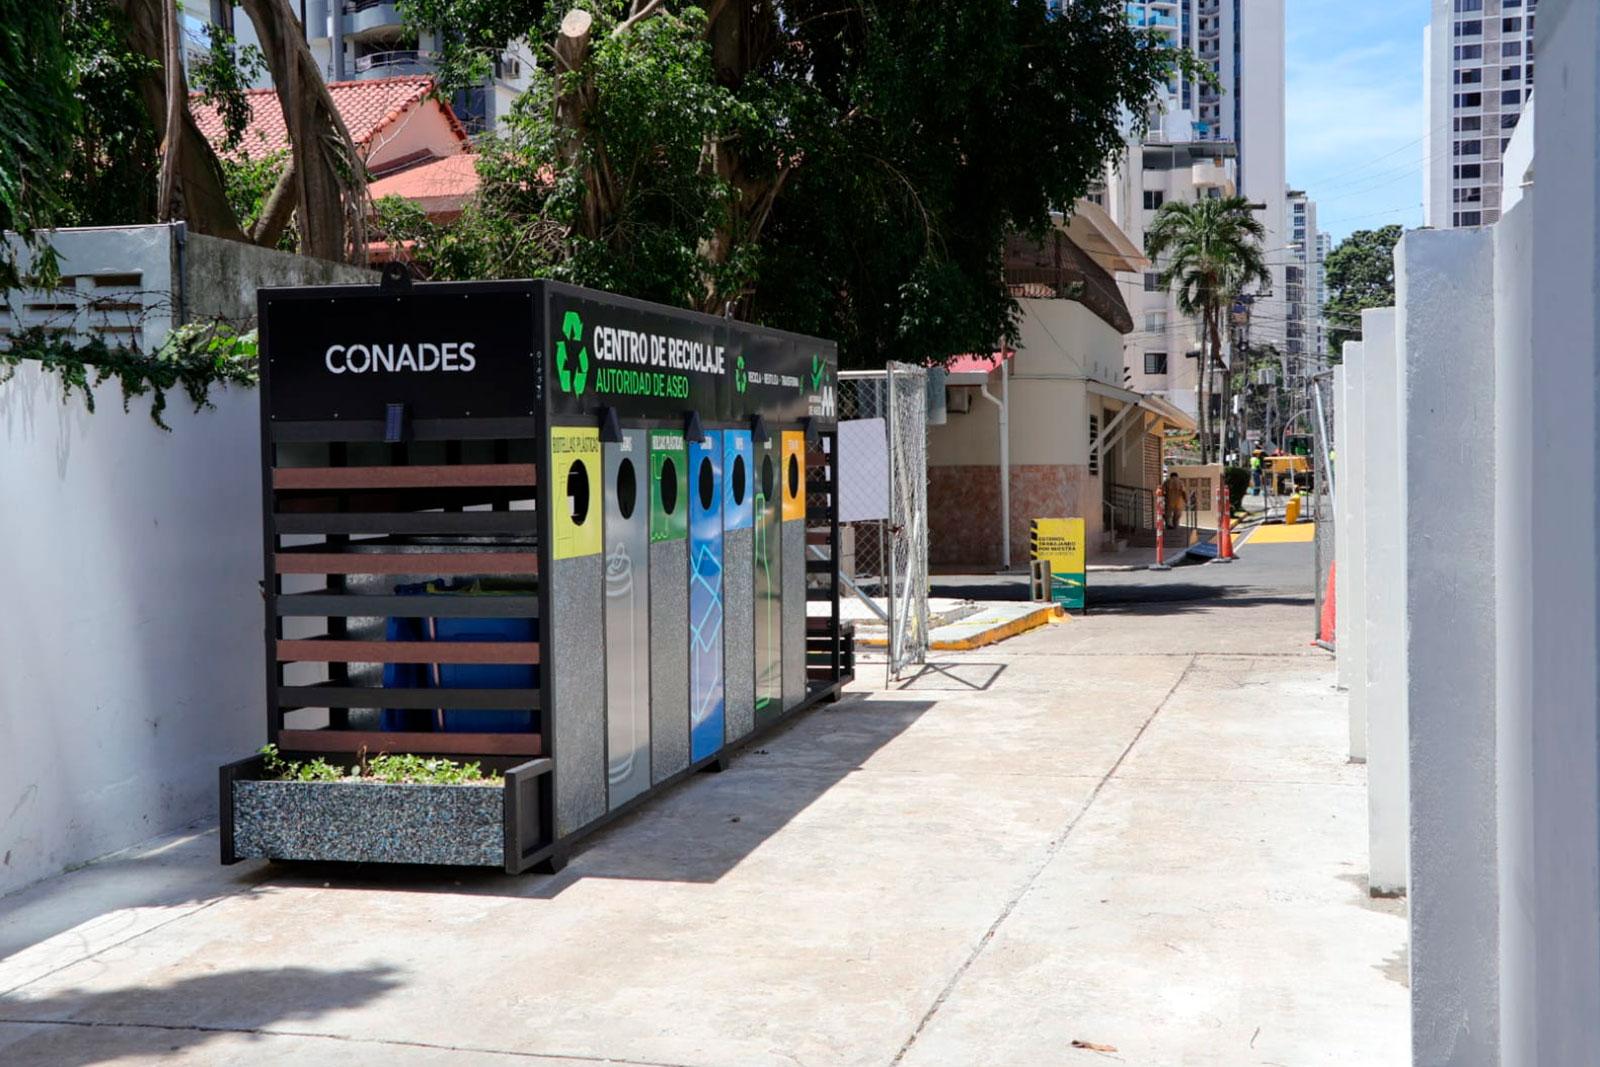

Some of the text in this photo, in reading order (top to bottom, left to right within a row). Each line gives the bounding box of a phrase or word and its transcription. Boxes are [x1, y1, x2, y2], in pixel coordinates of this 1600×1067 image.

[325, 342, 476, 374] CONADES
[593, 325, 726, 375] CENTRO DE RECICLAJE
[595, 367, 689, 399] AUTORIDAD DE ASEO
